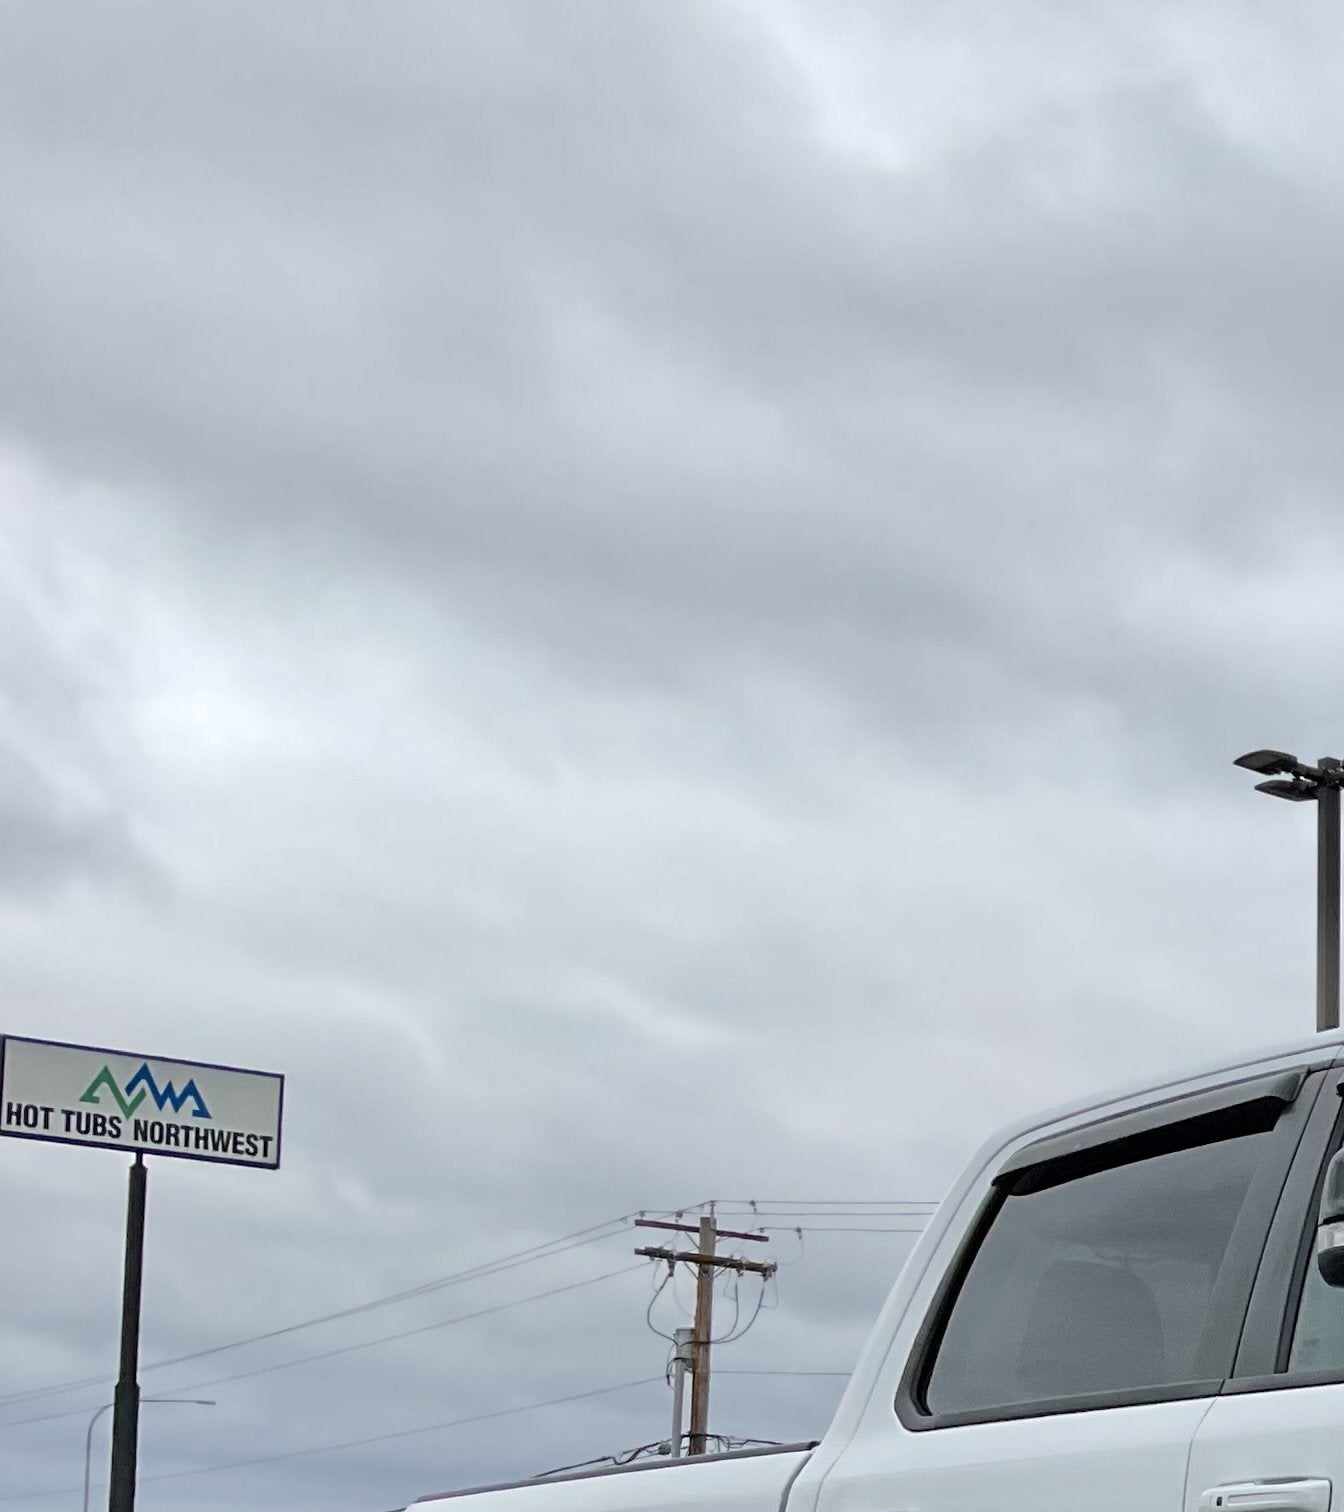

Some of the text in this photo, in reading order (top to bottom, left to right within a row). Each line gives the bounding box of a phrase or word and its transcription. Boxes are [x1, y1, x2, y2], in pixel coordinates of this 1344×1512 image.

[7, 1102, 273, 1158] HOT TUBS NORTHWEST
